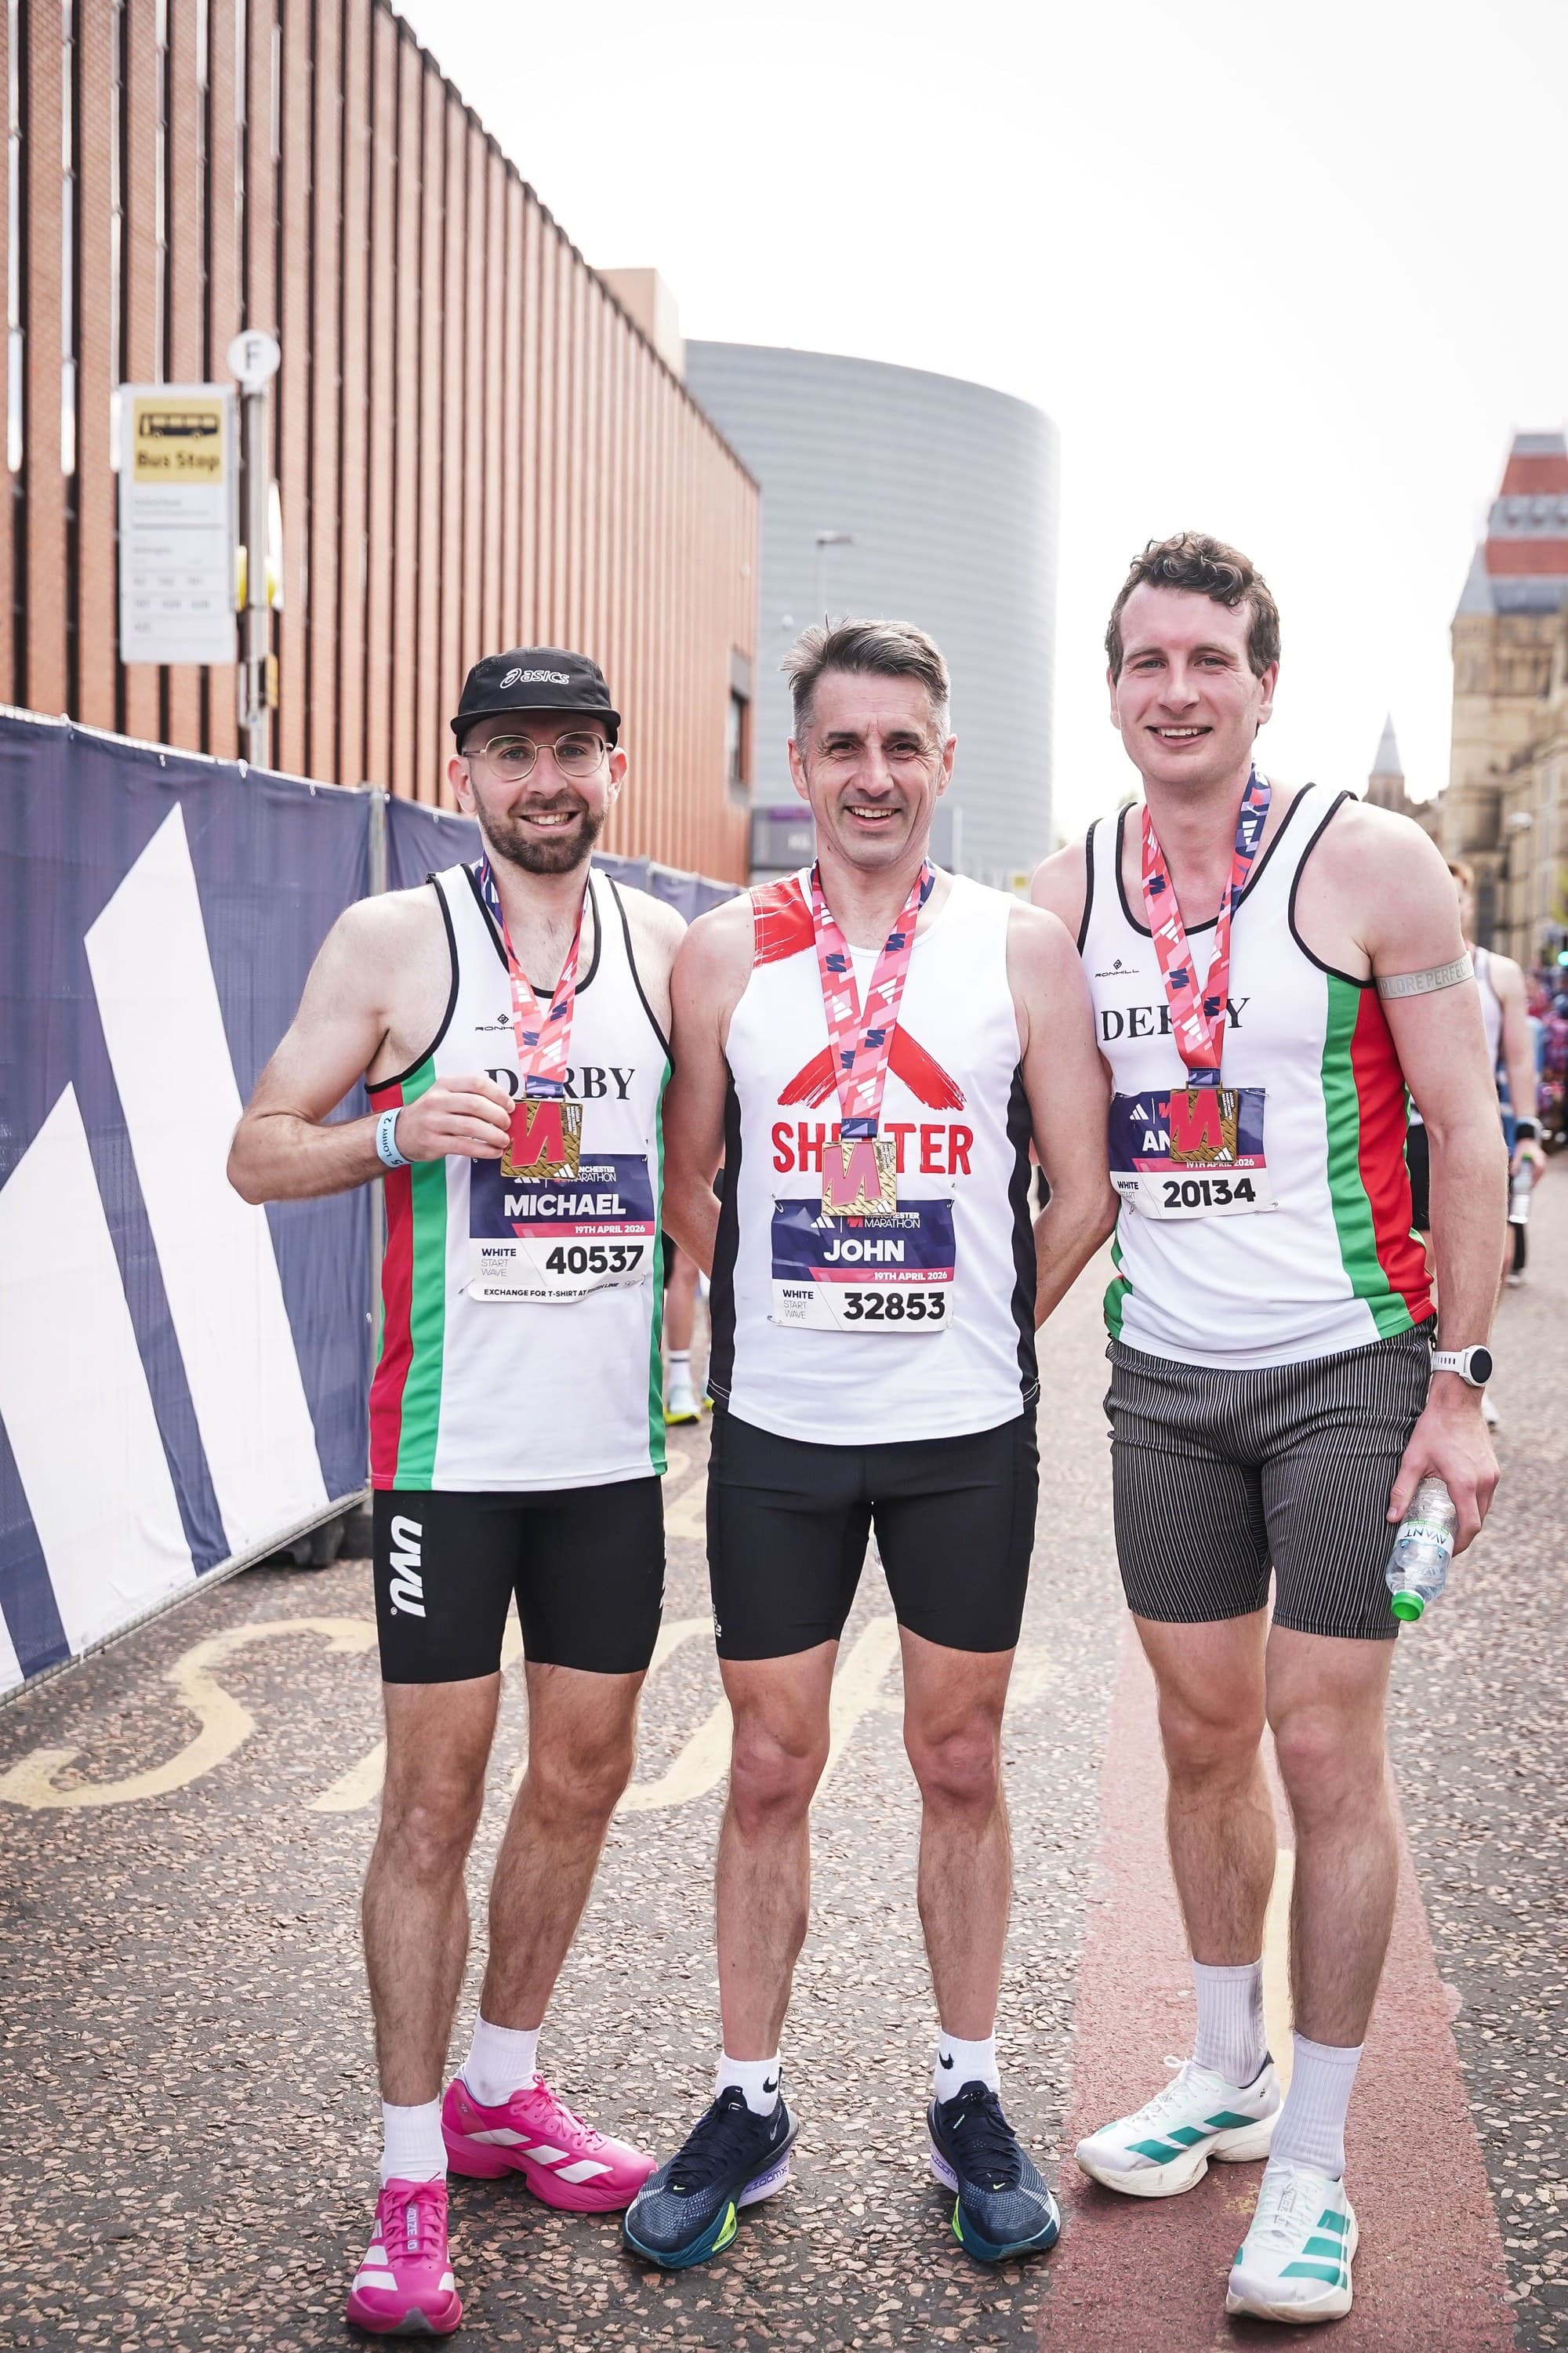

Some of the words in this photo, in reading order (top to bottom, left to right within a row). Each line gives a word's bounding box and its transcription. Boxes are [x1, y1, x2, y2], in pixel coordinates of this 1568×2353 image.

[245, 342, 260, 371] F
[136, 451, 169, 468] Bus
[176, 450, 220, 471] Stop
[521, 670, 570, 684] asics
[1095, 969, 1140, 978] RONHILL
[1101, 997, 1250, 1041] DEY
[484, 1066, 636, 1100] DRBY
[771, 1121, 974, 1175] SHTER
[572, 1172, 616, 1182] ARATHON
[1117, 1181, 1139, 1189] WHITE
[1163, 1178, 1256, 1207] 20134
[504, 1193, 626, 1216] MICHAEL
[575, 1226, 596, 1234] 19TH
[865, 1218, 920, 1229] MARATHON
[824, 1239, 905, 1262] JOHN
[481, 1248, 517, 1257] WHITE
[546, 1245, 644, 1274] 40537
[481, 1258, 509, 1267] START
[899, 1272, 926, 1280] APRIL
[927, 1271, 947, 1280] 2026
[484, 1288, 528, 1297] EXCHANGE
[782, 1290, 813, 1299] WHITE
[843, 1292, 946, 1320] 32853
[784, 1300, 807, 1309] START
[785, 1310, 806, 1319] WAVE
[1404, 1528, 1446, 1545] AVANT
[407, 2207, 418, 2250] ADIZEO
